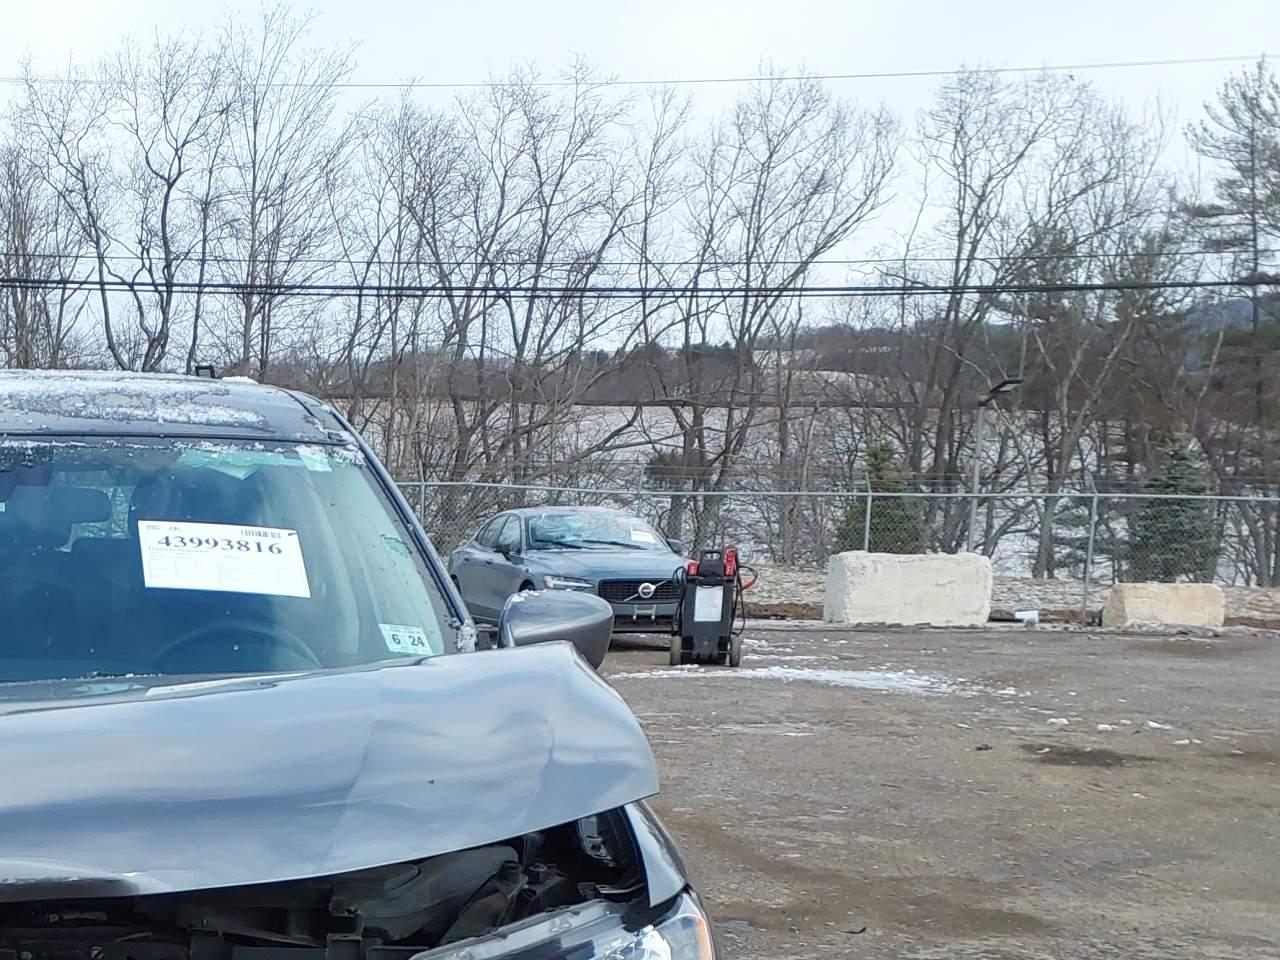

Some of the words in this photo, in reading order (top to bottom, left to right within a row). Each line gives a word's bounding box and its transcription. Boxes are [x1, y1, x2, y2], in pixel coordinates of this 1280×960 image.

[158, 535, 283, 555] 43993816
[391, 633, 401, 645] 6
[408, 635, 425, 647] 24
